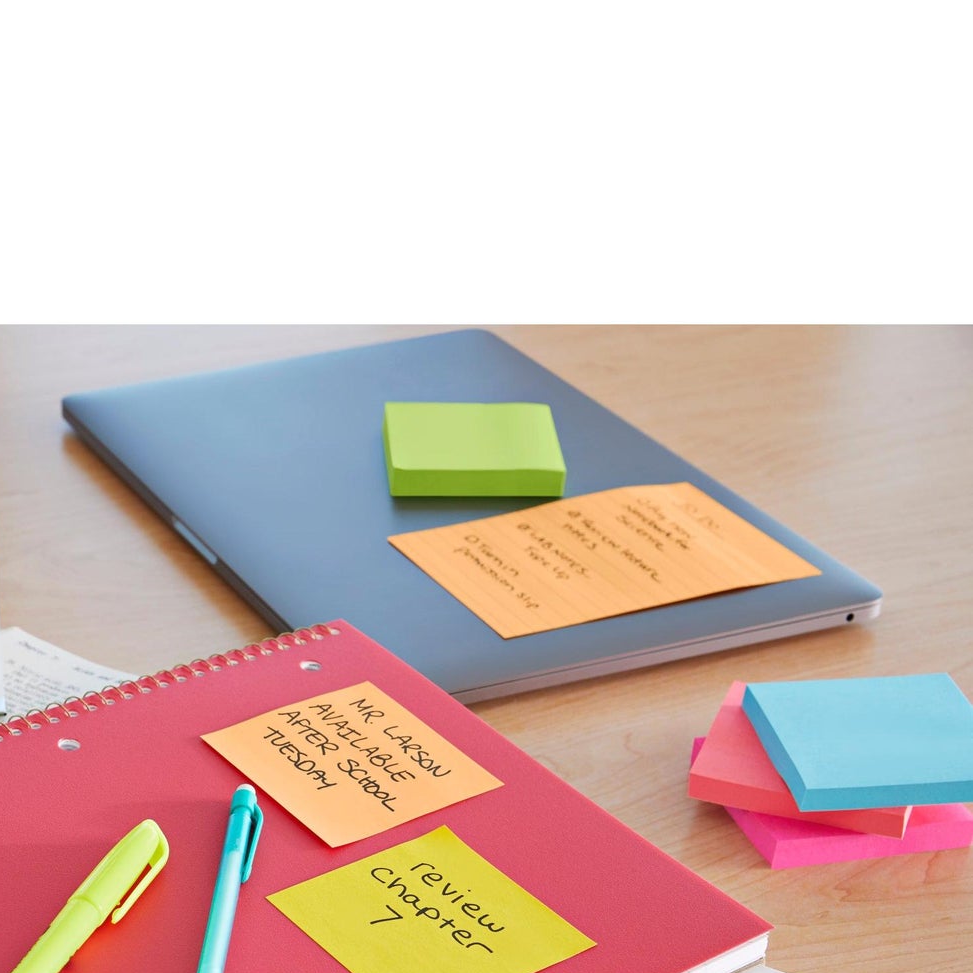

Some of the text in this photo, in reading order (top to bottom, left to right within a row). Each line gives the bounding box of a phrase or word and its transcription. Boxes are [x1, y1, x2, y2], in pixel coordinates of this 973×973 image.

[263, 726, 338, 790] TUESDAY
[278, 710, 398, 812] AFTER SCHOOL
[308, 703, 416, 783] AVAILABLE
[349, 698, 452, 779] MR. LARSON
[370, 904, 404, 925] 7
[409, 862, 505, 933] review
